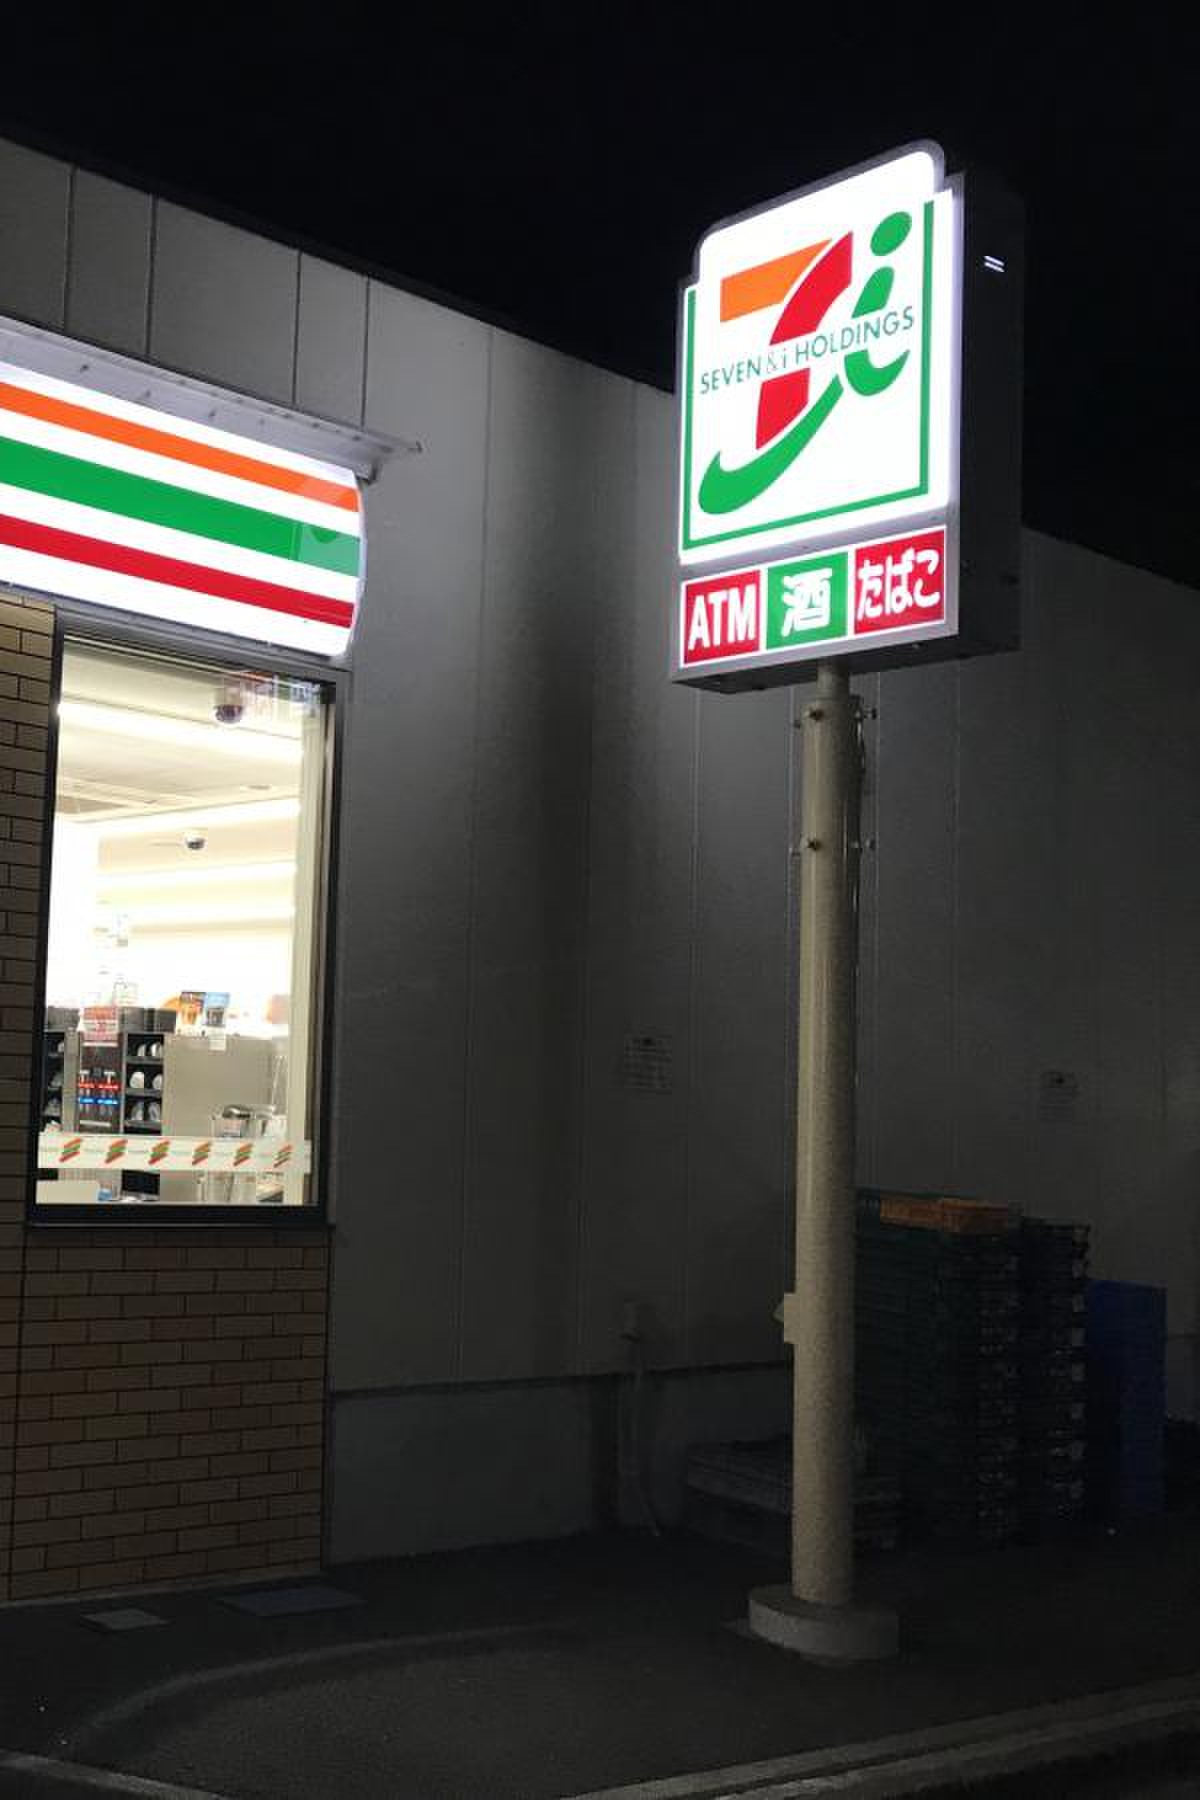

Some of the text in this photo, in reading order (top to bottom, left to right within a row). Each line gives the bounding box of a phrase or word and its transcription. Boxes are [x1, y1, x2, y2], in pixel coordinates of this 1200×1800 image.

[795, 305, 915, 365] HOLDINGS
[688, 583, 757, 651] ATM
[781, 567, 833, 637] 酒
[857, 548, 940, 621] たばこ
